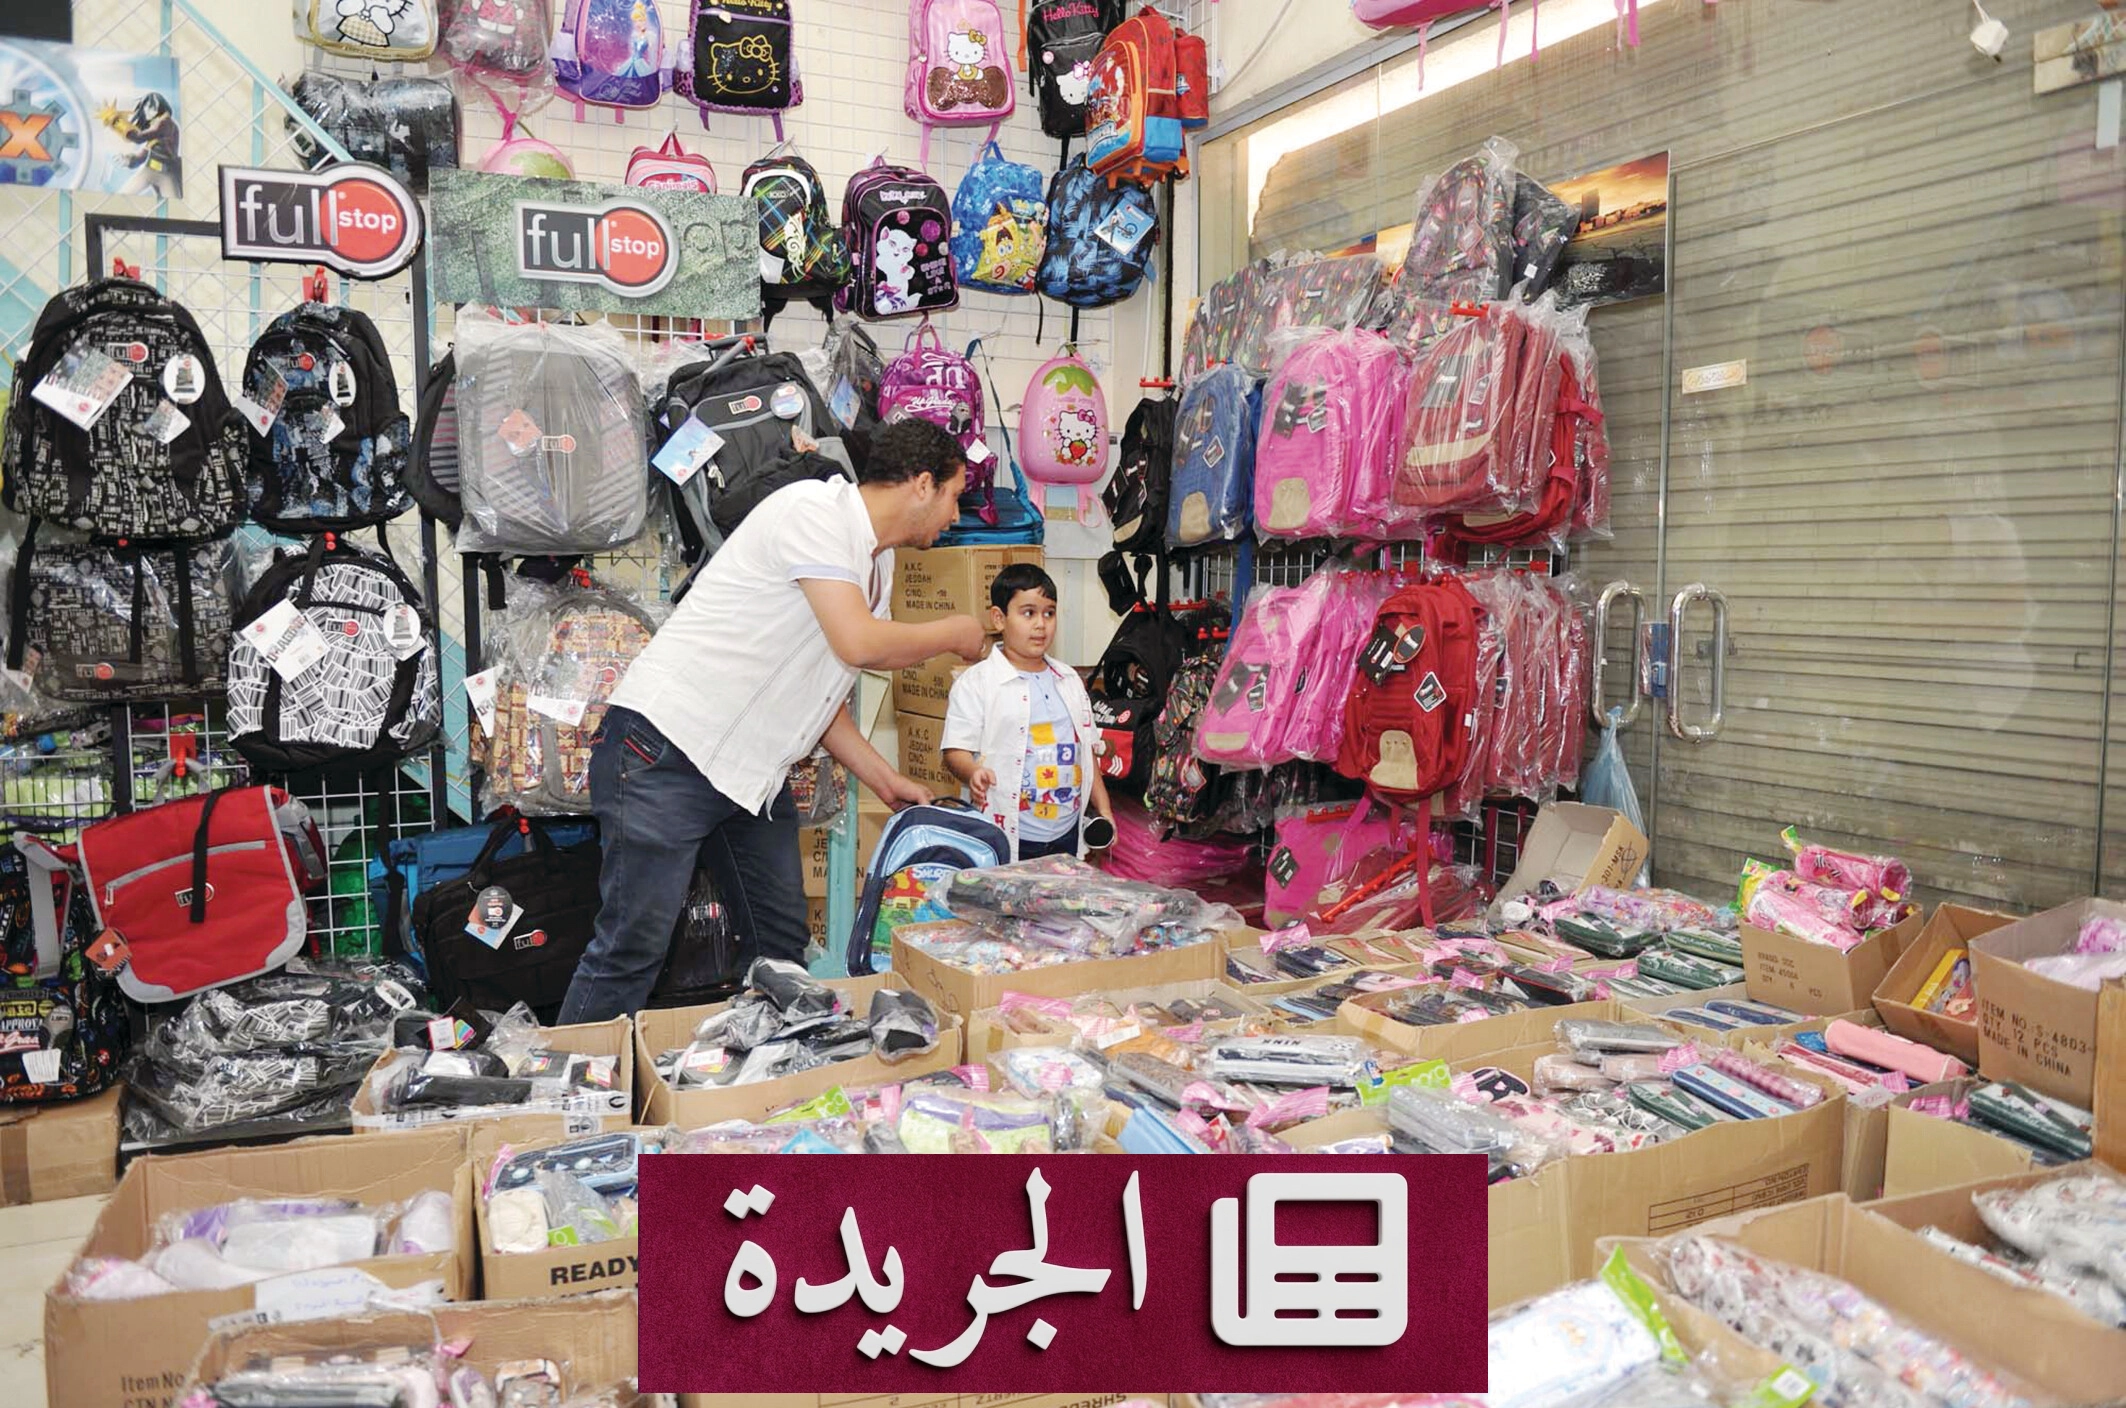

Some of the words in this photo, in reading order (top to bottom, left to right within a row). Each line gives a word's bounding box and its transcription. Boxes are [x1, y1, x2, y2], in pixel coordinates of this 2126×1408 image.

[239, 184, 339, 246] full
[339, 208, 397, 234] stop
[527, 213, 611, 270] full
[611, 236, 660, 259] stop
[934, 601, 956, 611] CHINA
[1981, 999, 2005, 1020] ITEM
[1984, 1026, 2011, 1049] MADE
[2017, 1044, 2029, 1059] IN
[2036, 1053, 2072, 1077] CHINA
[2013, 1028, 2024, 1042] 12
[2034, 1038, 2058, 1058] PCS
